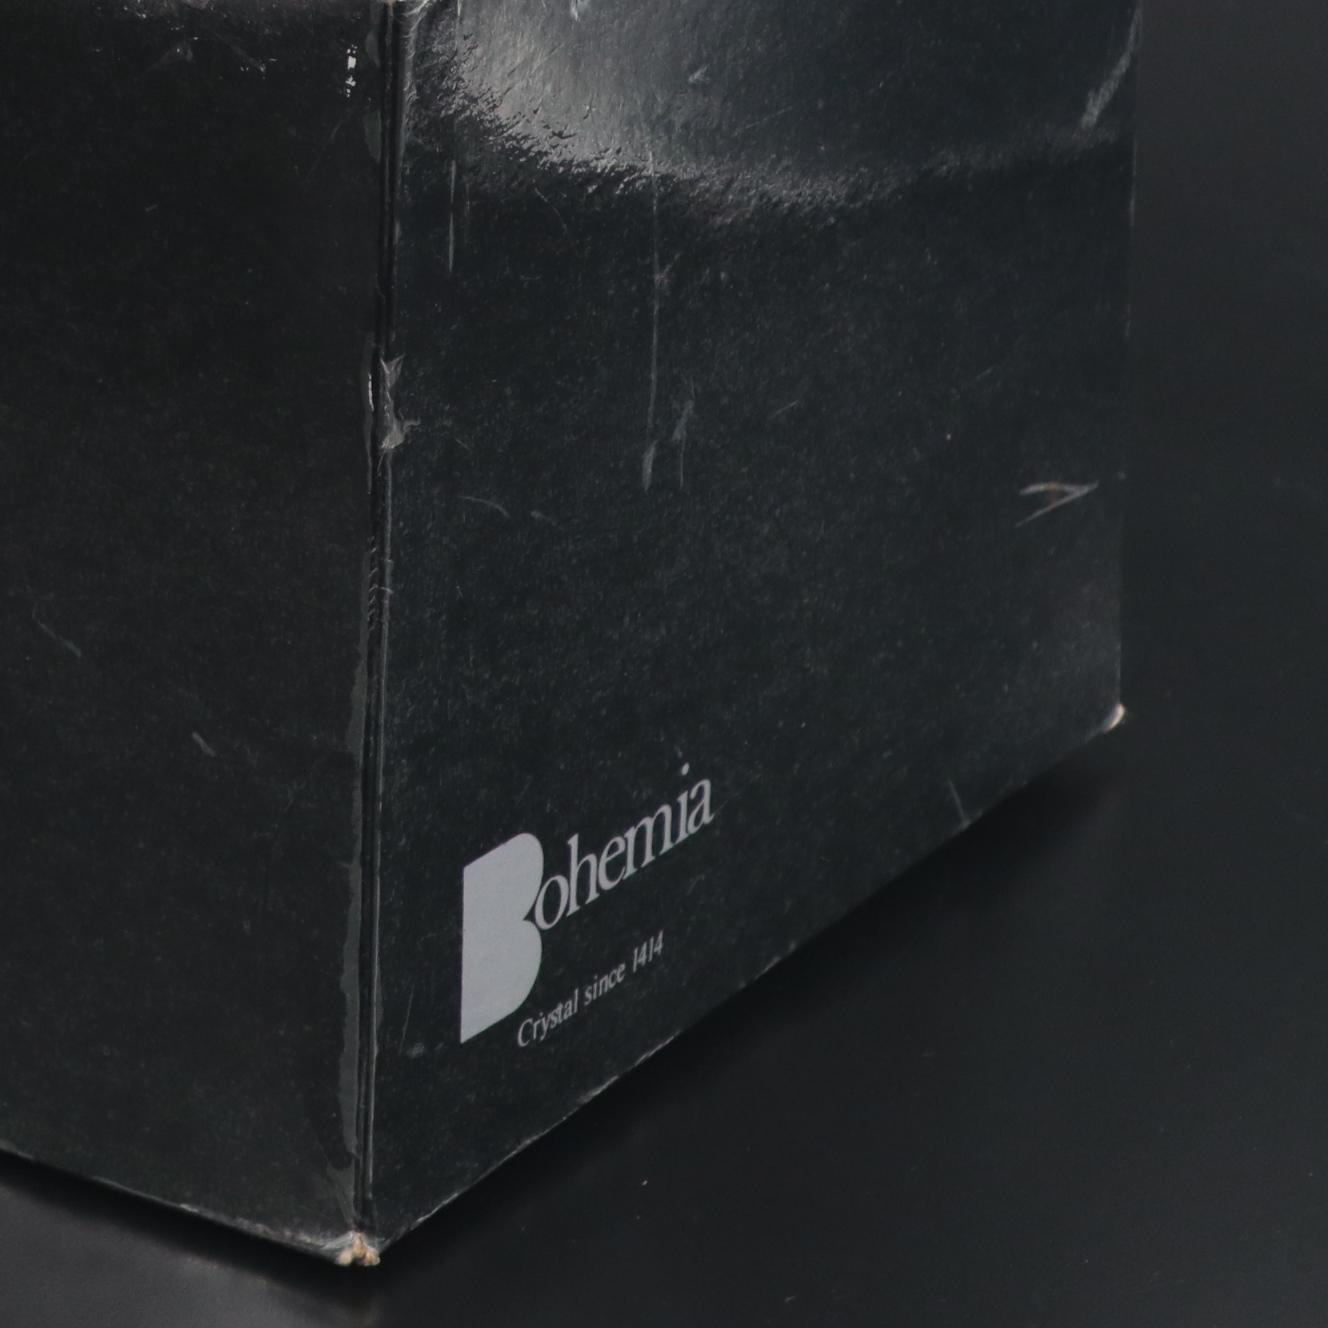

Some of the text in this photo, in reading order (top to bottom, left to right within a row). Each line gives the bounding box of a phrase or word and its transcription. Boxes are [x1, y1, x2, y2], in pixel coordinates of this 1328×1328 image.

[460, 762, 715, 1045] Bohemia
[516, 987, 580, 1048] Crystal
[583, 962, 627, 1007] since
